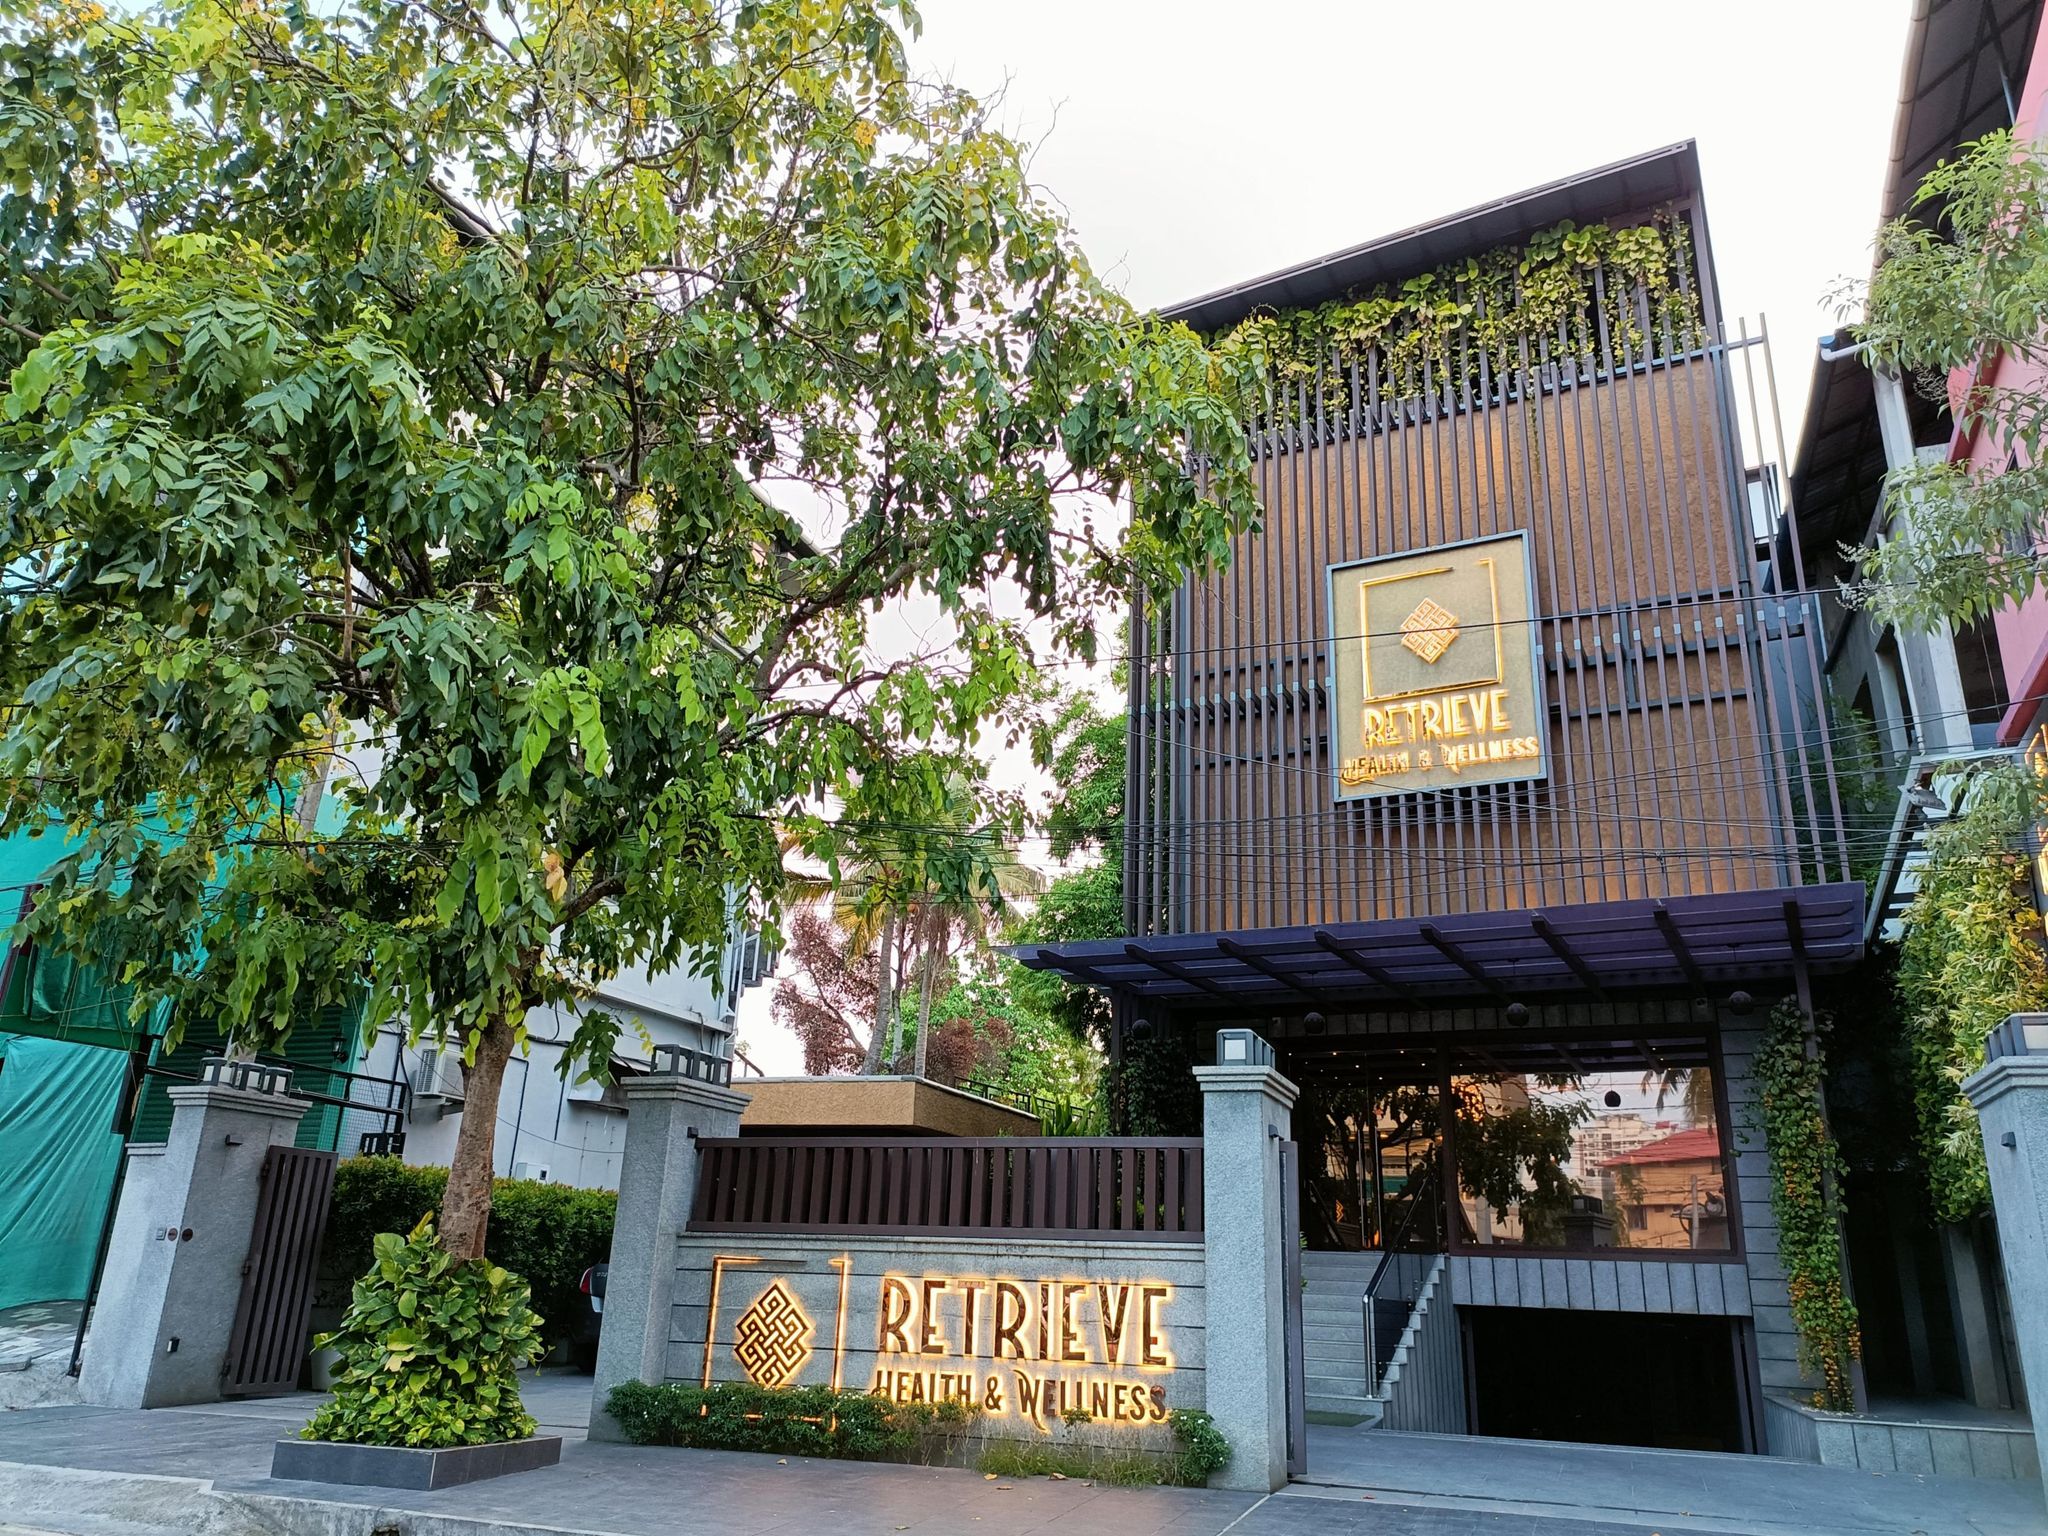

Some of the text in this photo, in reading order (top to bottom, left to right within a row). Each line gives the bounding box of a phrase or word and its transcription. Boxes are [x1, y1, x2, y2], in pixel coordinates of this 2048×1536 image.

[1364, 688, 1511, 748] RETRIEVE
[1341, 736, 1540, 785] HEALTH & WELLNESS
[879, 1277, 1168, 1366] RETRIEVE
[871, 1369, 1167, 1431] HEALTH & WELLNESS
